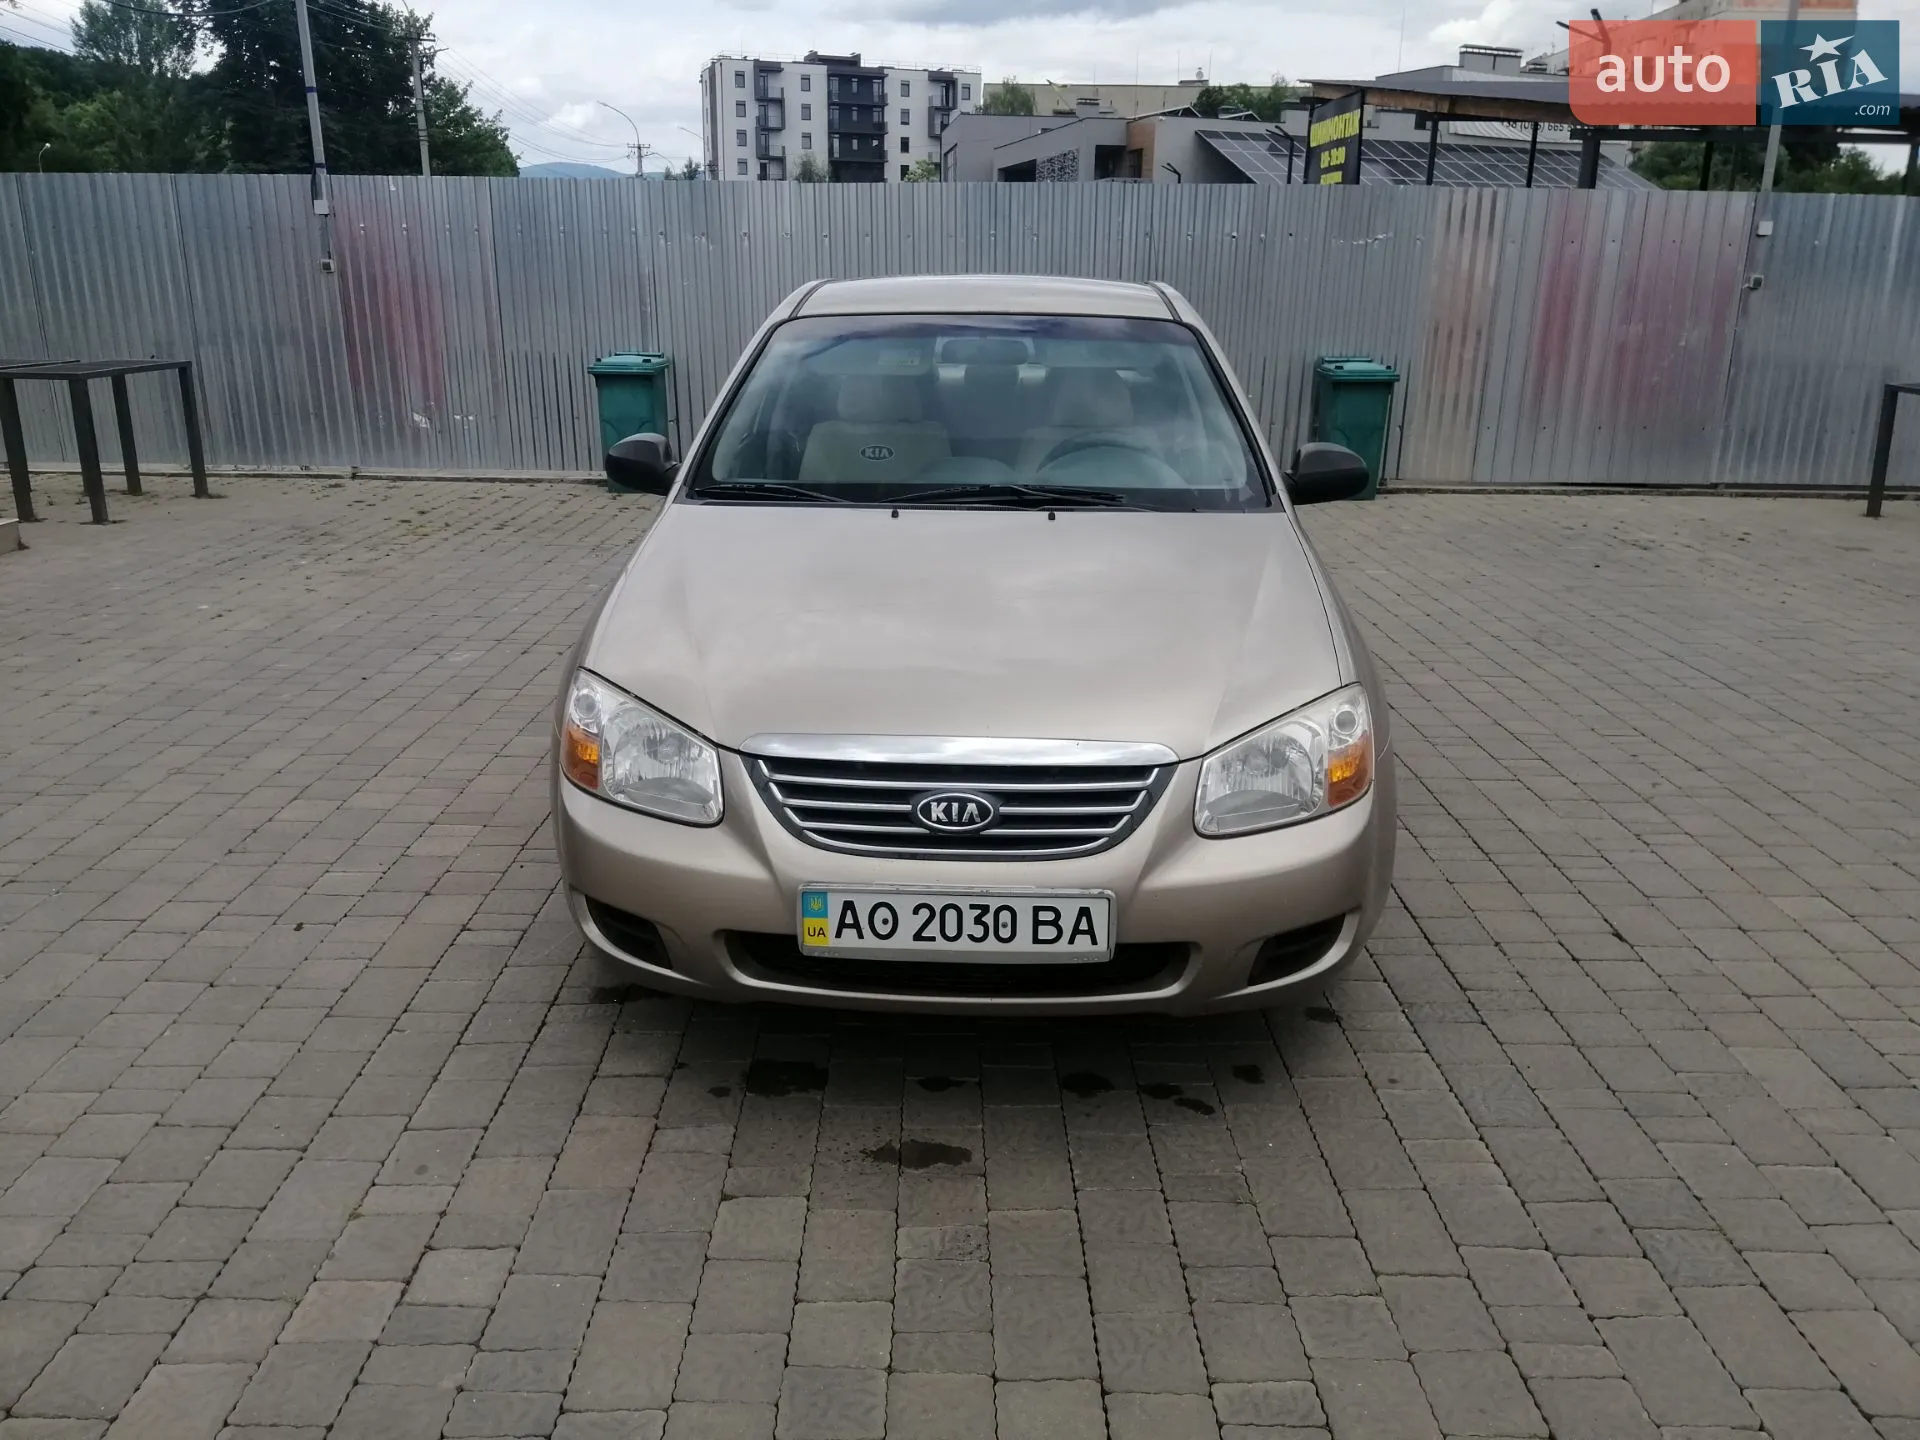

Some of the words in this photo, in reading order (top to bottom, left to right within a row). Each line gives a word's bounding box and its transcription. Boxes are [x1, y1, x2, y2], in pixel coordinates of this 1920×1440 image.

[864, 447, 890, 458] KIA
[930, 802, 981, 823] KIA
[807, 926, 826, 938] UA
[834, 900, 899, 941] AO
[912, 903, 1018, 944] 2030
[1032, 905, 1098, 946] BA
